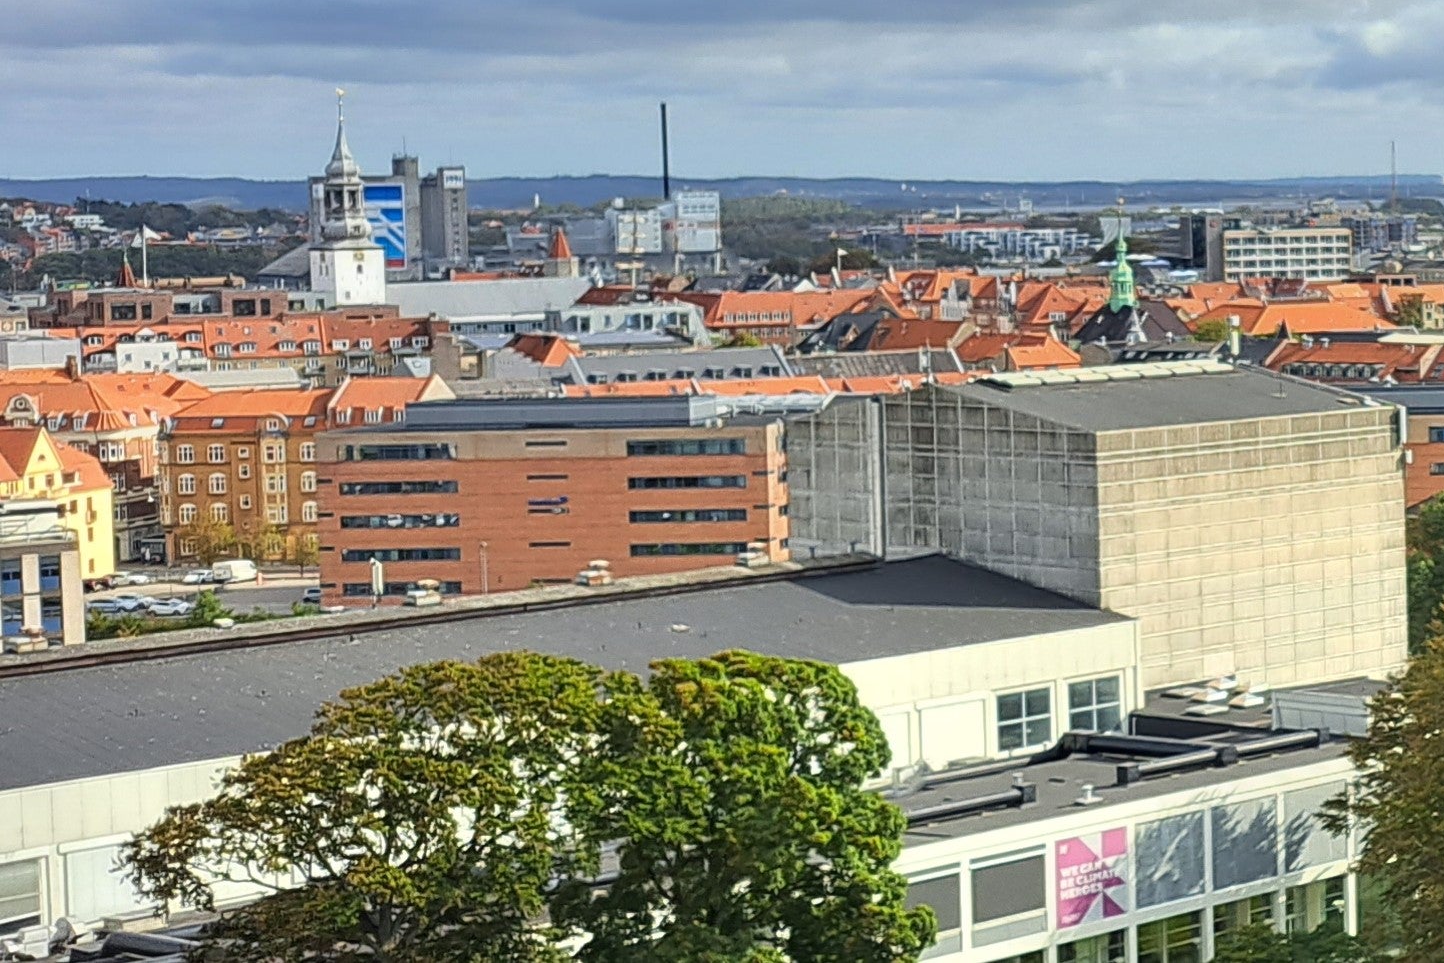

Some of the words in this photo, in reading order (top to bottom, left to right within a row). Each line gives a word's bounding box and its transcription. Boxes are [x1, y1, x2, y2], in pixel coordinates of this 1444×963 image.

[1060, 866, 1078, 877] WE
[1079, 860, 1103, 873] CAN
[1060, 877, 1075, 889] BE
[1060, 882, 1103, 900] HEROES
